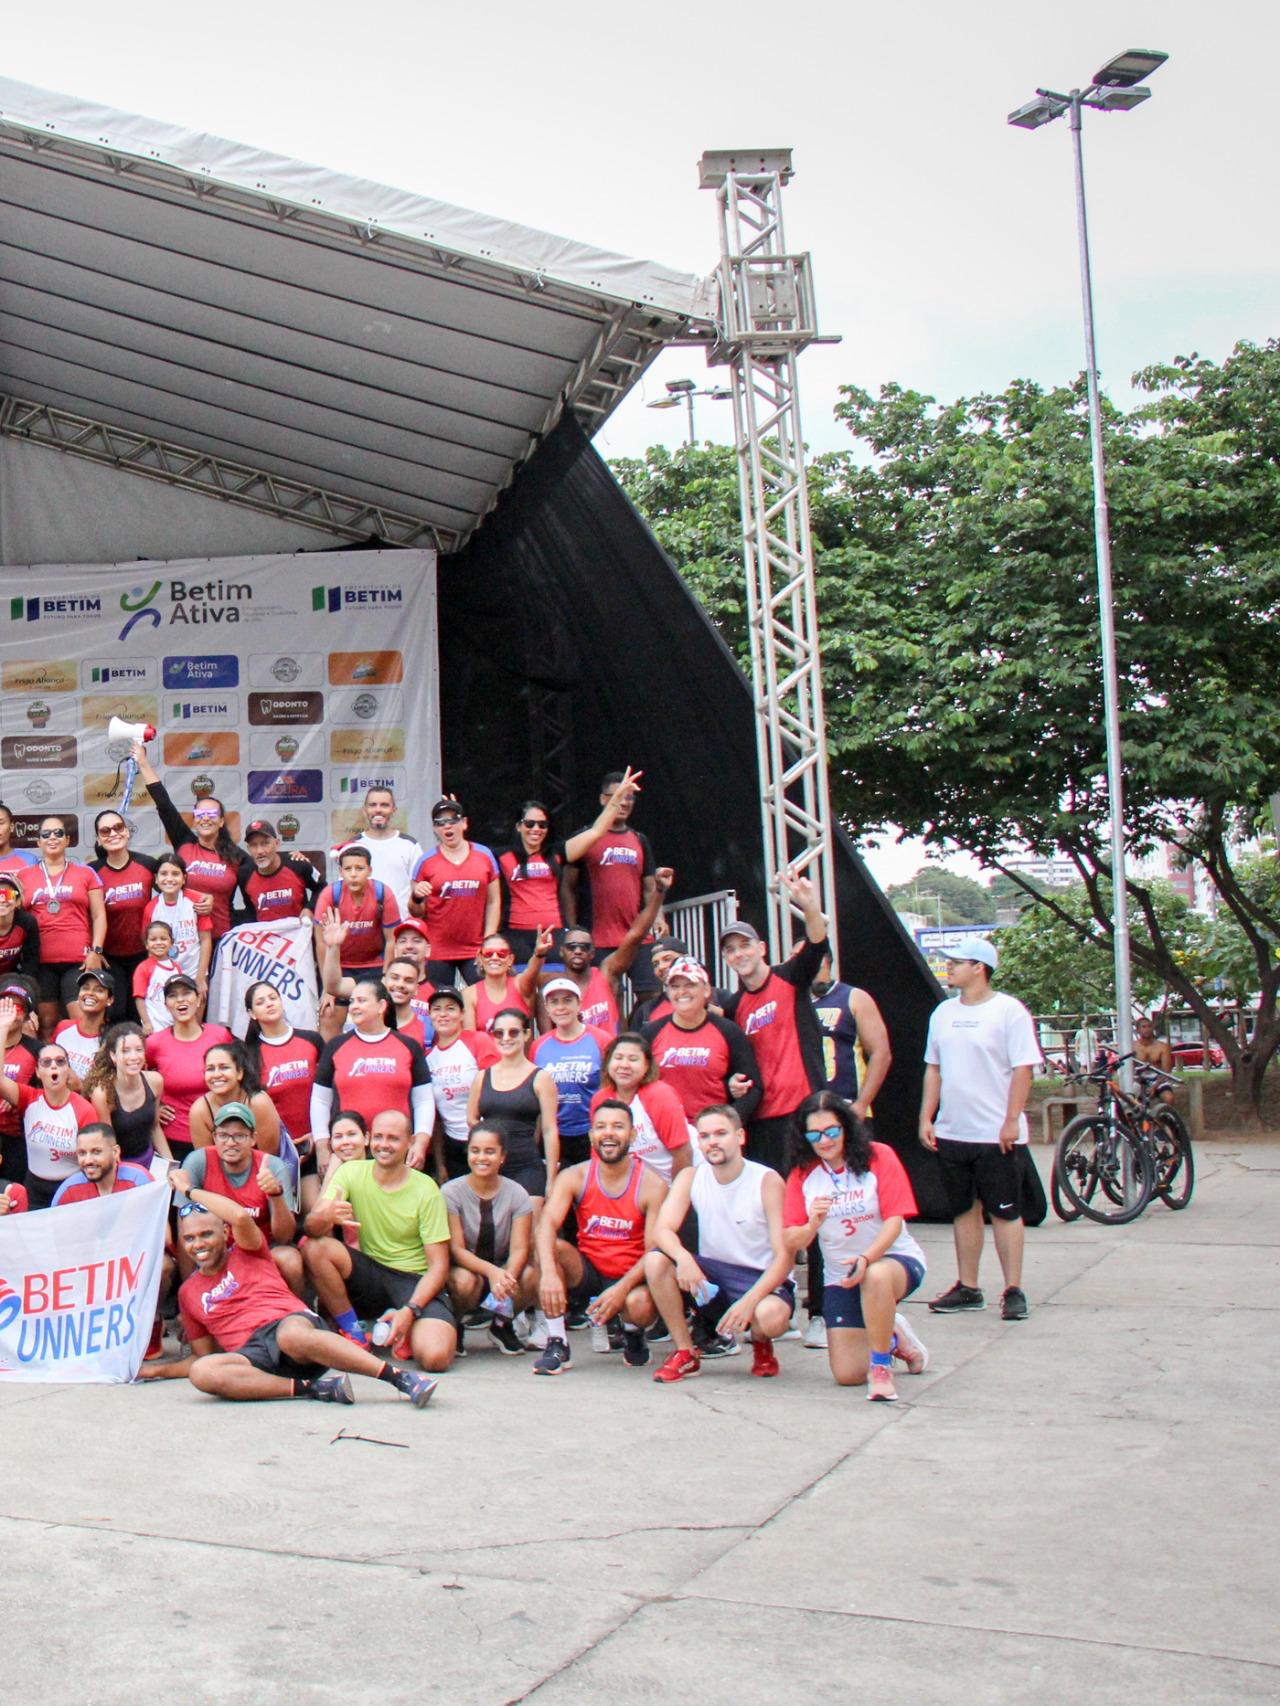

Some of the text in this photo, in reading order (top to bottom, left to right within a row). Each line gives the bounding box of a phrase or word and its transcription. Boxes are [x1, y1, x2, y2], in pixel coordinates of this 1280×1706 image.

[170, 580, 252, 601] Betim
[344, 590, 402, 602] BETIM
[44, 599, 101, 612] BETIM
[170, 602, 240, 625] Ativa
[187, 661, 218, 671] Betim
[111, 670, 146, 678] BETIM
[187, 670, 213, 678] Ativa
[192, 705, 227, 714] BETIM
[26, 744, 62, 752] ODONTO
[360, 778, 394, 788] BETIM
[613, 846, 638, 857] BETIM
[199, 860, 227, 872] BETIM
[115, 882, 143, 894] BETIM
[451, 880, 480, 890] BETIM
[266, 888, 293, 900] BETIM
[349, 920, 374, 929] BETIM
[238, 930, 297, 966] BET
[677, 1047, 710, 1057] BETIM
[279, 1060, 309, 1073] BETIM
[366, 1057, 397, 1066] BETIM
[555, 1061, 593, 1073] BETIM
[4, 1064, 20, 1073] TIM
[44, 1123, 74, 1138] BETIM
[50, 1149, 60, 1161] 3
[599, 1216, 634, 1229] BETIM
[840, 1213, 875, 1237] 3 anos
[23, 1251, 145, 1314] BETIM
